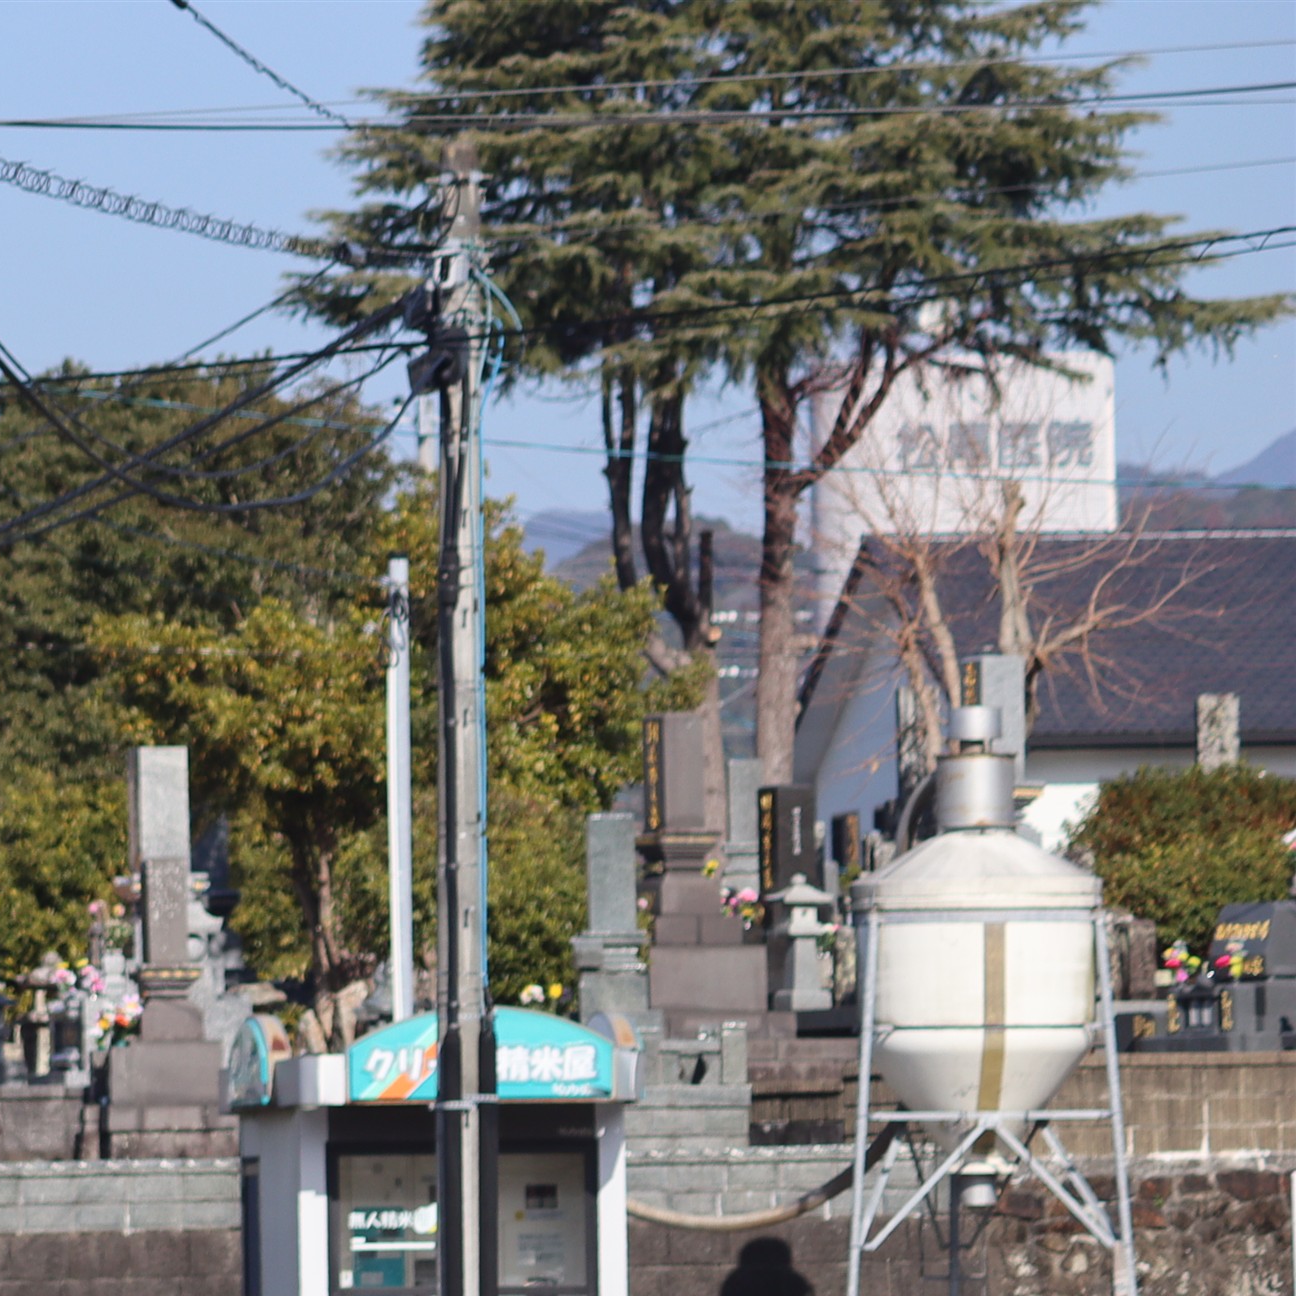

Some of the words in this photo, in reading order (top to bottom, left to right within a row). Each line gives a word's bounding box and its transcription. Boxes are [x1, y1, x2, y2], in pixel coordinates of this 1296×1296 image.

[365, 1045, 598, 1082] クリ精米屋
